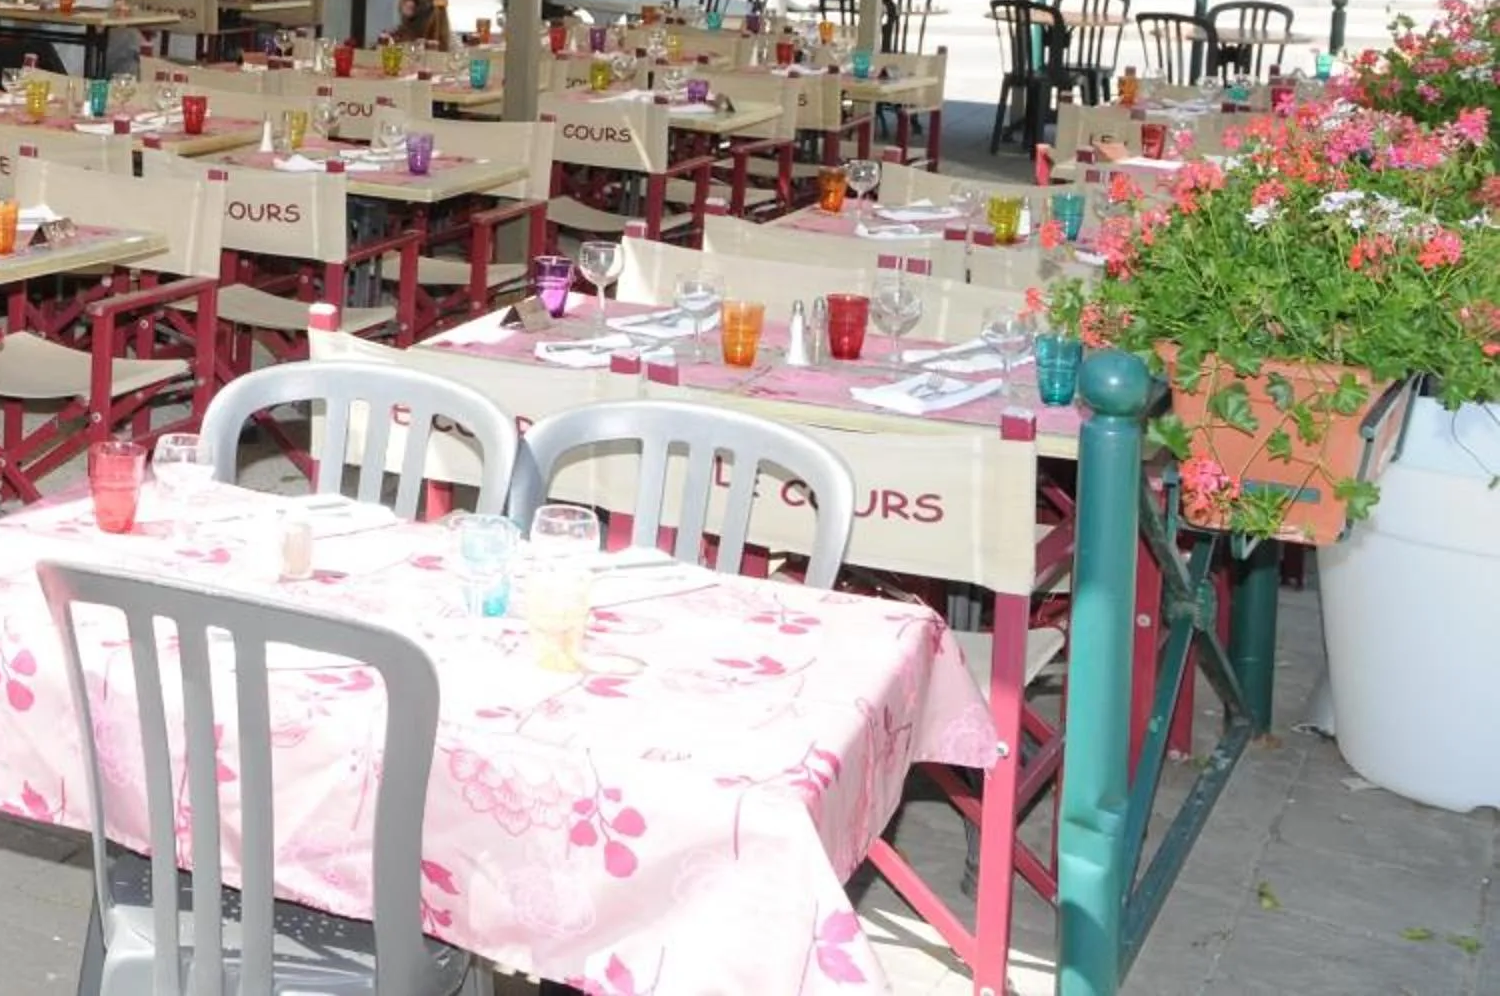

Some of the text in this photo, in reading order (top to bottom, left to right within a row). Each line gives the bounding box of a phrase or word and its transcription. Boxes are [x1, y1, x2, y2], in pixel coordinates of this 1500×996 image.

[563, 123, 632, 143] COURS
[227, 201, 301, 223] OURS
[780, 478, 945, 524] CURS
